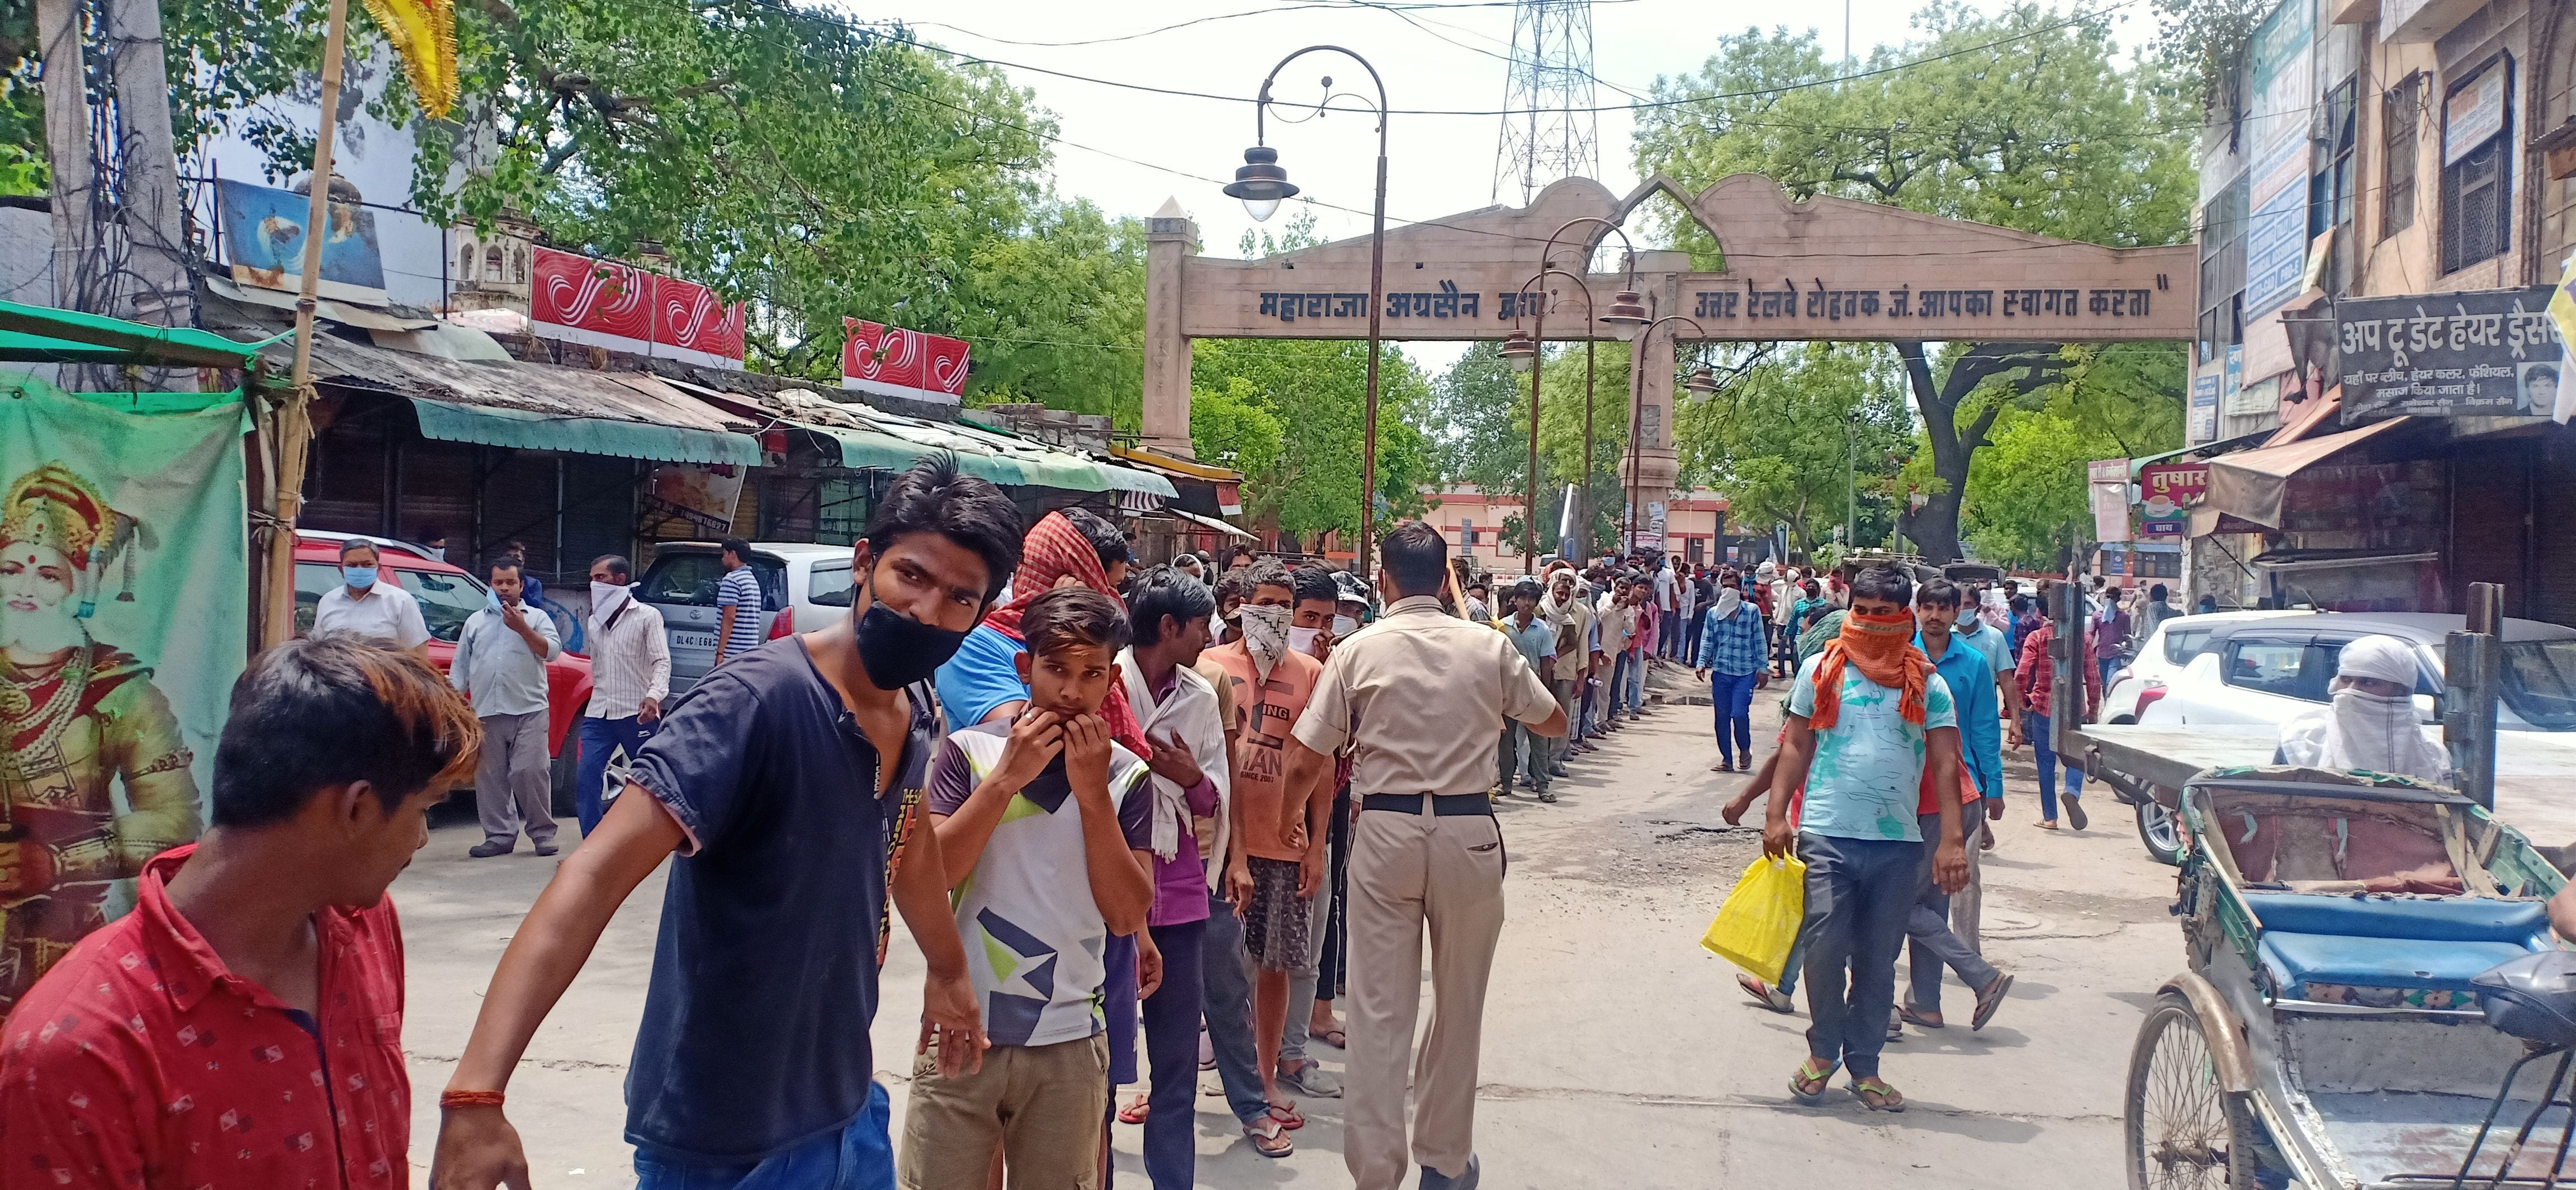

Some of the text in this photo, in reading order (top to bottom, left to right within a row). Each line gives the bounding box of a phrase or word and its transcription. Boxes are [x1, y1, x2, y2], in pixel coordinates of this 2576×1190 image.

[2281, 259, 2299, 283] PRO-E
[1259, 292, 1368, 322] महाराजा
[1386, 279, 1480, 318] अग्रसैन
[1695, 292, 1739, 318] उत्तर
[1748, 277, 1798, 318] रेलवे
[1807, 277, 1879, 320] रोहतक
[1919, 289, 1993, 317] आपका
[2003, 289, 2079, 316] स्वागत
[2341, 319, 2382, 355] अप
[2387, 318, 2409, 367] टू
[2409, 304, 2445, 353] डेट
[2449, 301, 2503, 351] हेयर
[2343, 370, 2364, 386] यहाँ
[2365, 372, 2379, 383] पर
[2411, 367, 2433, 381] हेयर
[2376, 386, 2408, 398] मसाज
[2411, 382, 2435, 395] किया
[2437, 385, 2464, 395] जाता
[2151, 470, 2208, 493] तुषार
[1240, 771, 1275, 783] SINCE 2007
